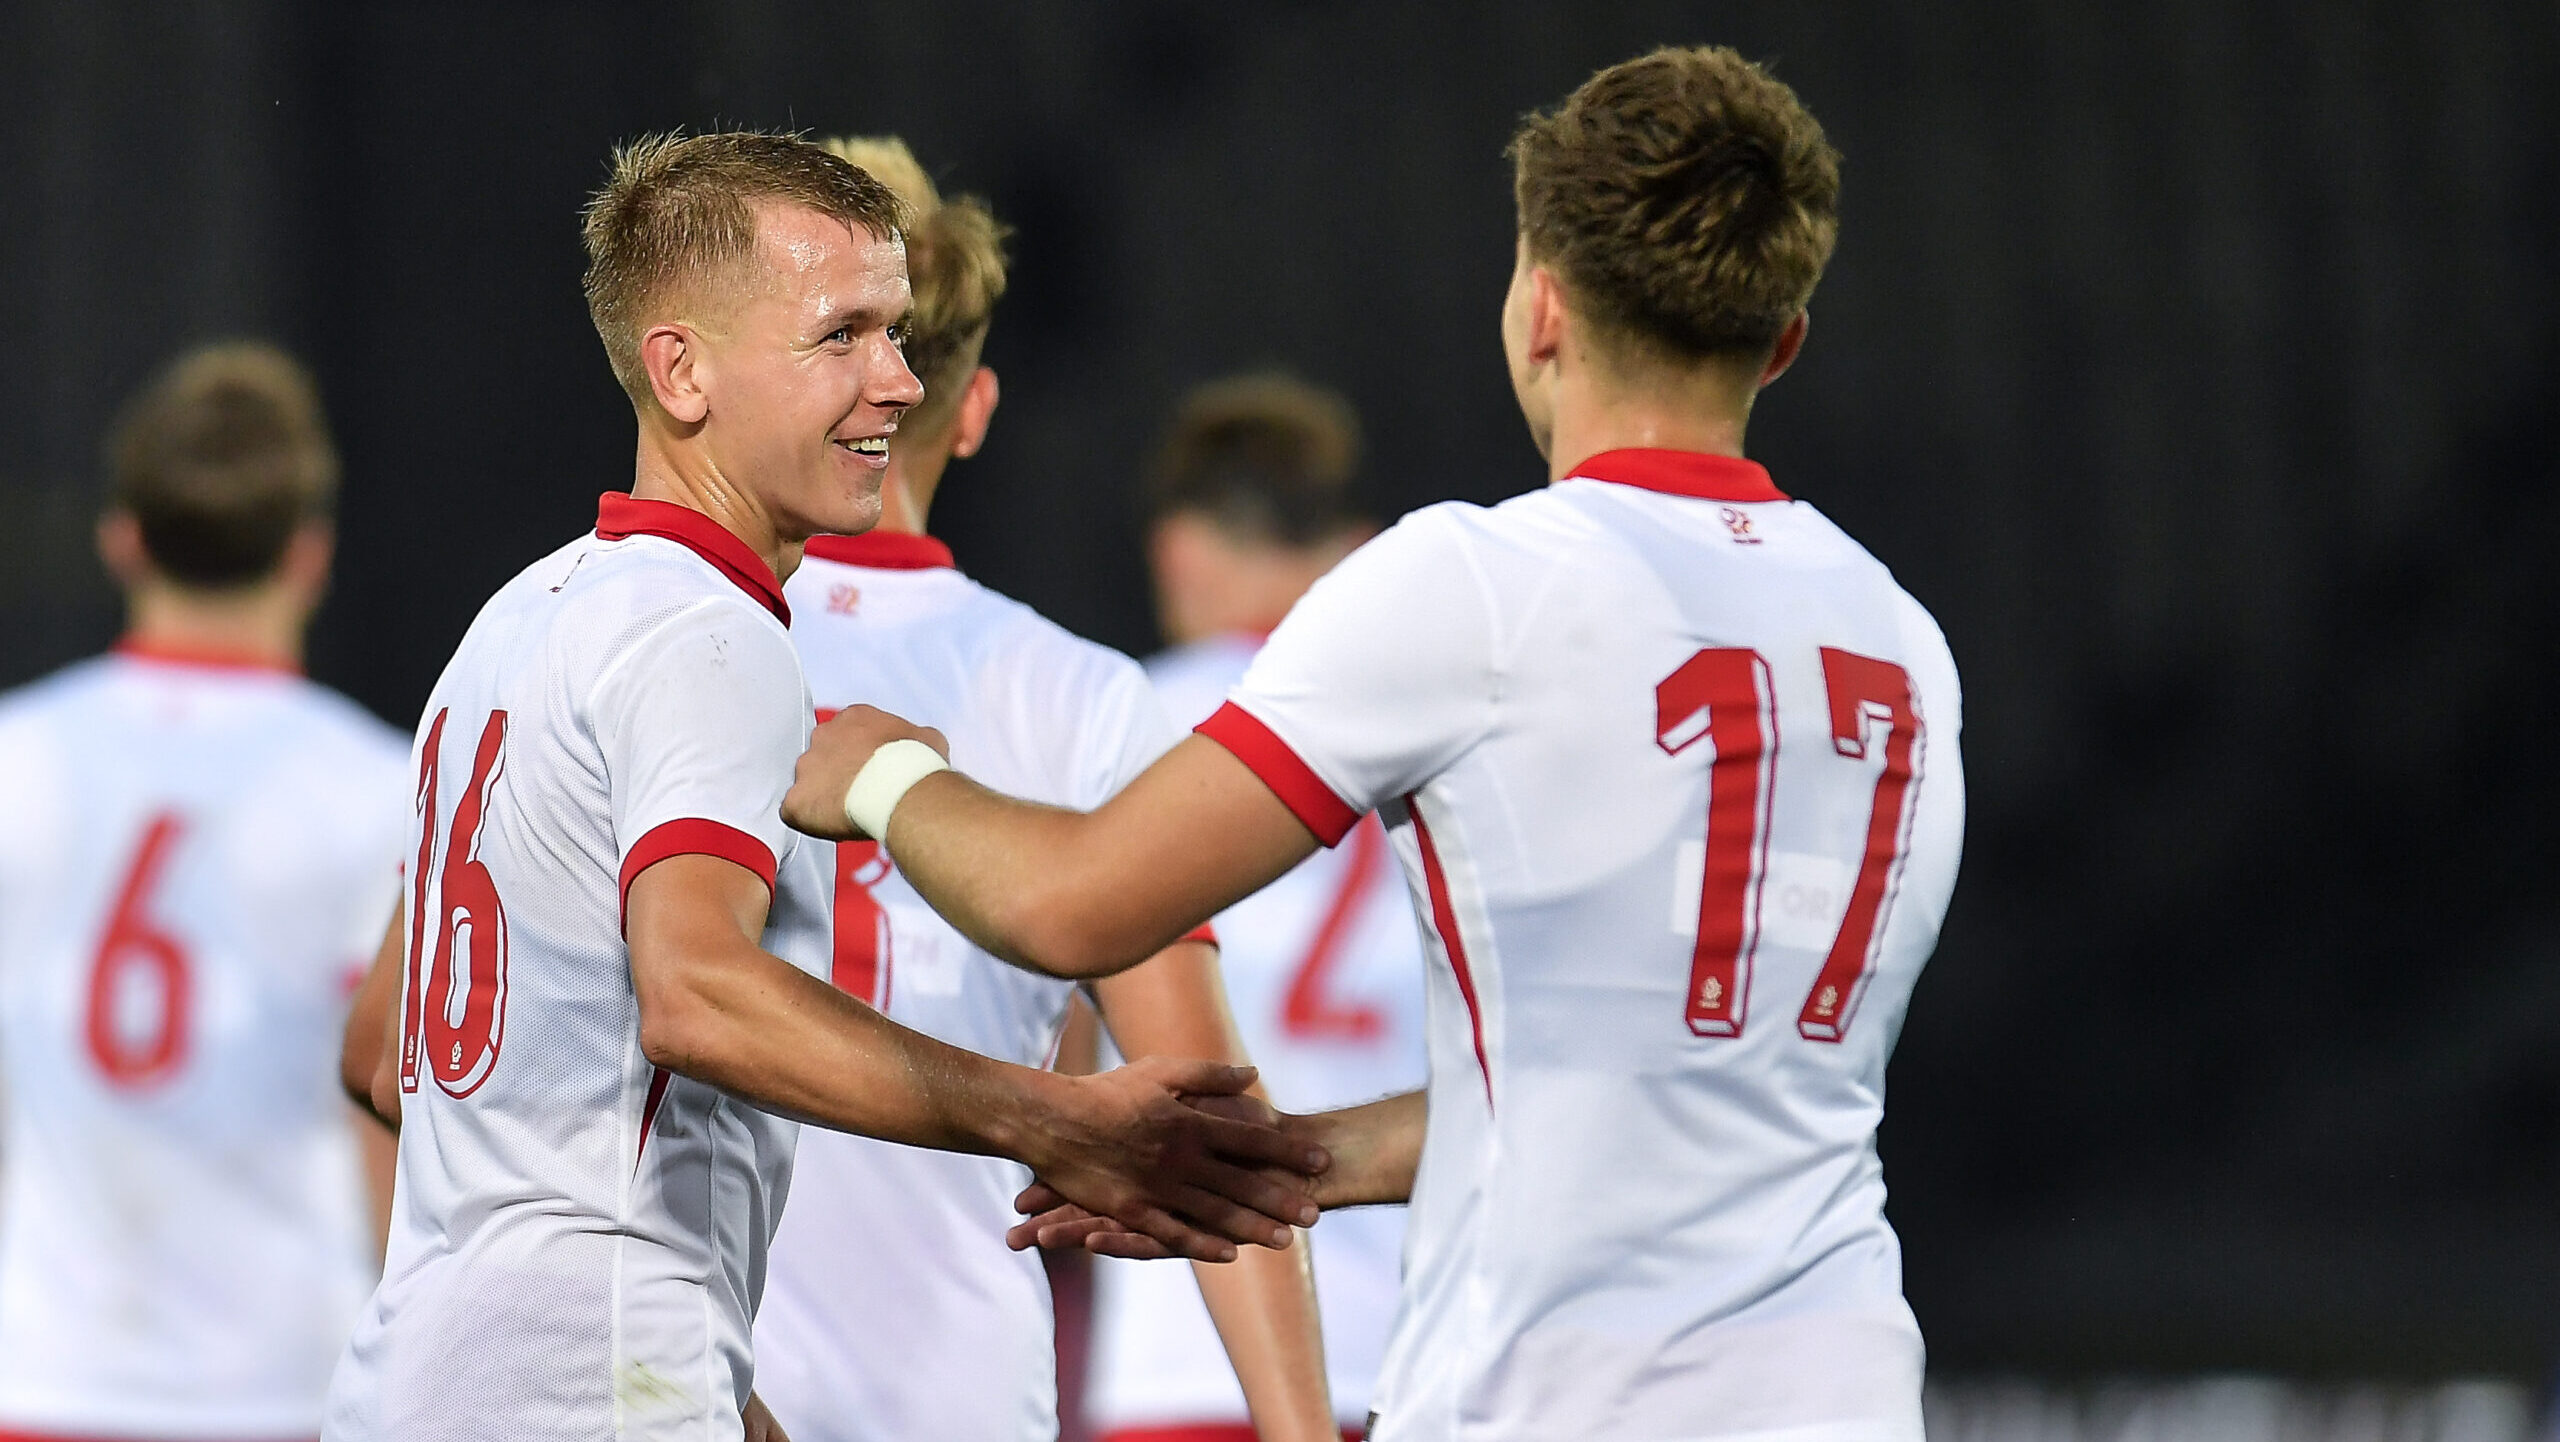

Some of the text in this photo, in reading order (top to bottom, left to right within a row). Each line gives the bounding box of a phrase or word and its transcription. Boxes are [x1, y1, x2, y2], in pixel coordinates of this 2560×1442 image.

[86, 806, 192, 1090] 6
[400, 706, 508, 1100] 16
[1655, 646, 1927, 1043] 17
